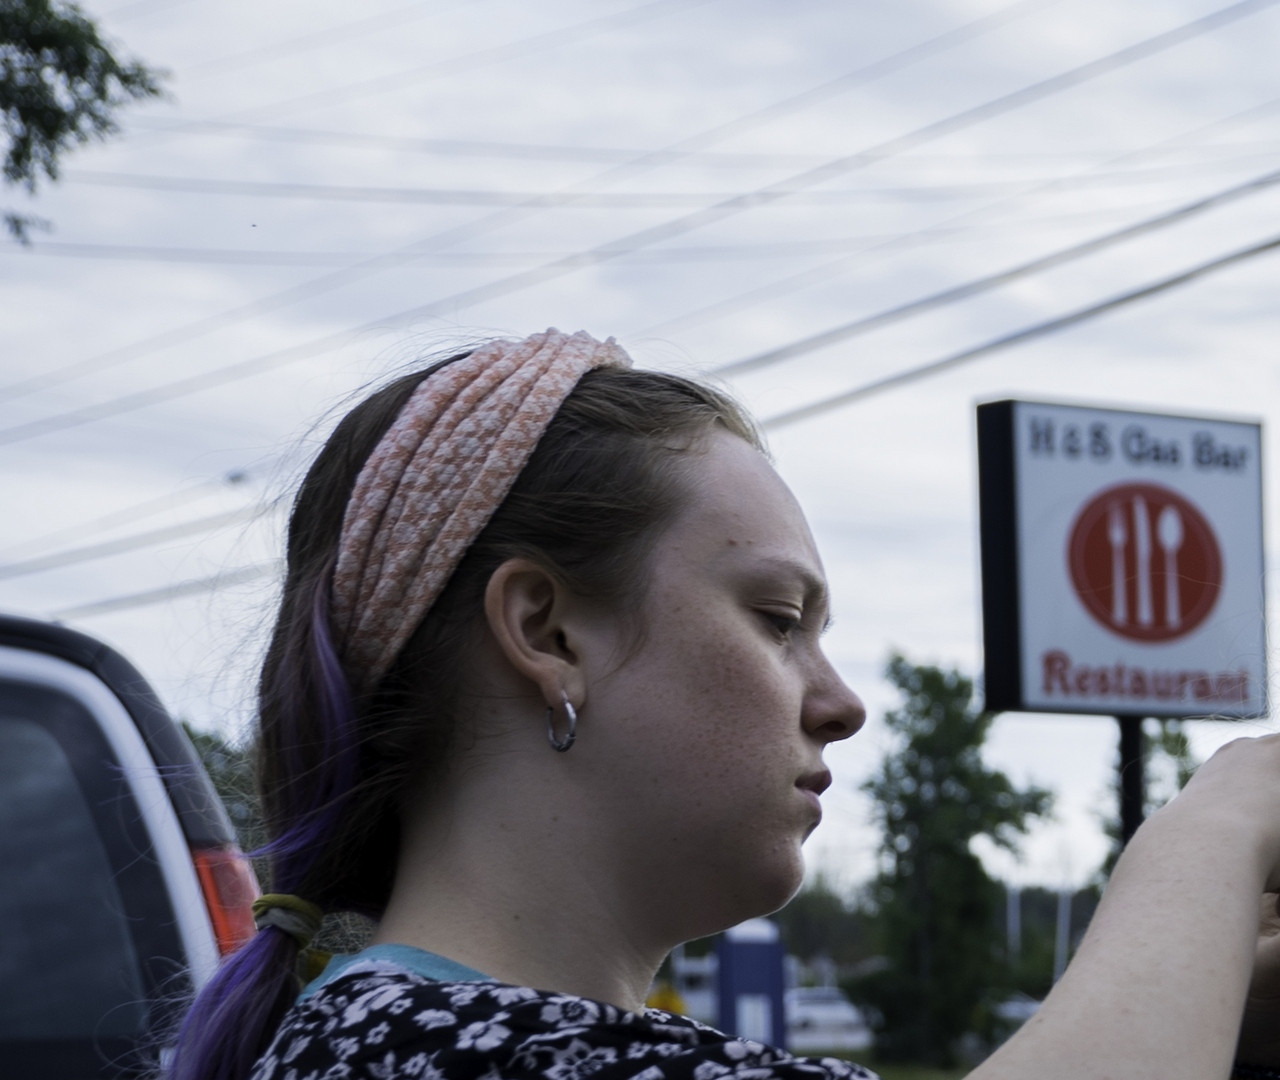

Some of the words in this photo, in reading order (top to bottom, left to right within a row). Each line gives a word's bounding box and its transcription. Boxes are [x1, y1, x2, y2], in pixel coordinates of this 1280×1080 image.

[1029, 418, 1055, 455] H
[1121, 423, 1180, 465] Gas
[1192, 430, 1247, 470] Bar
[1042, 649, 1250, 704] Restaurant
